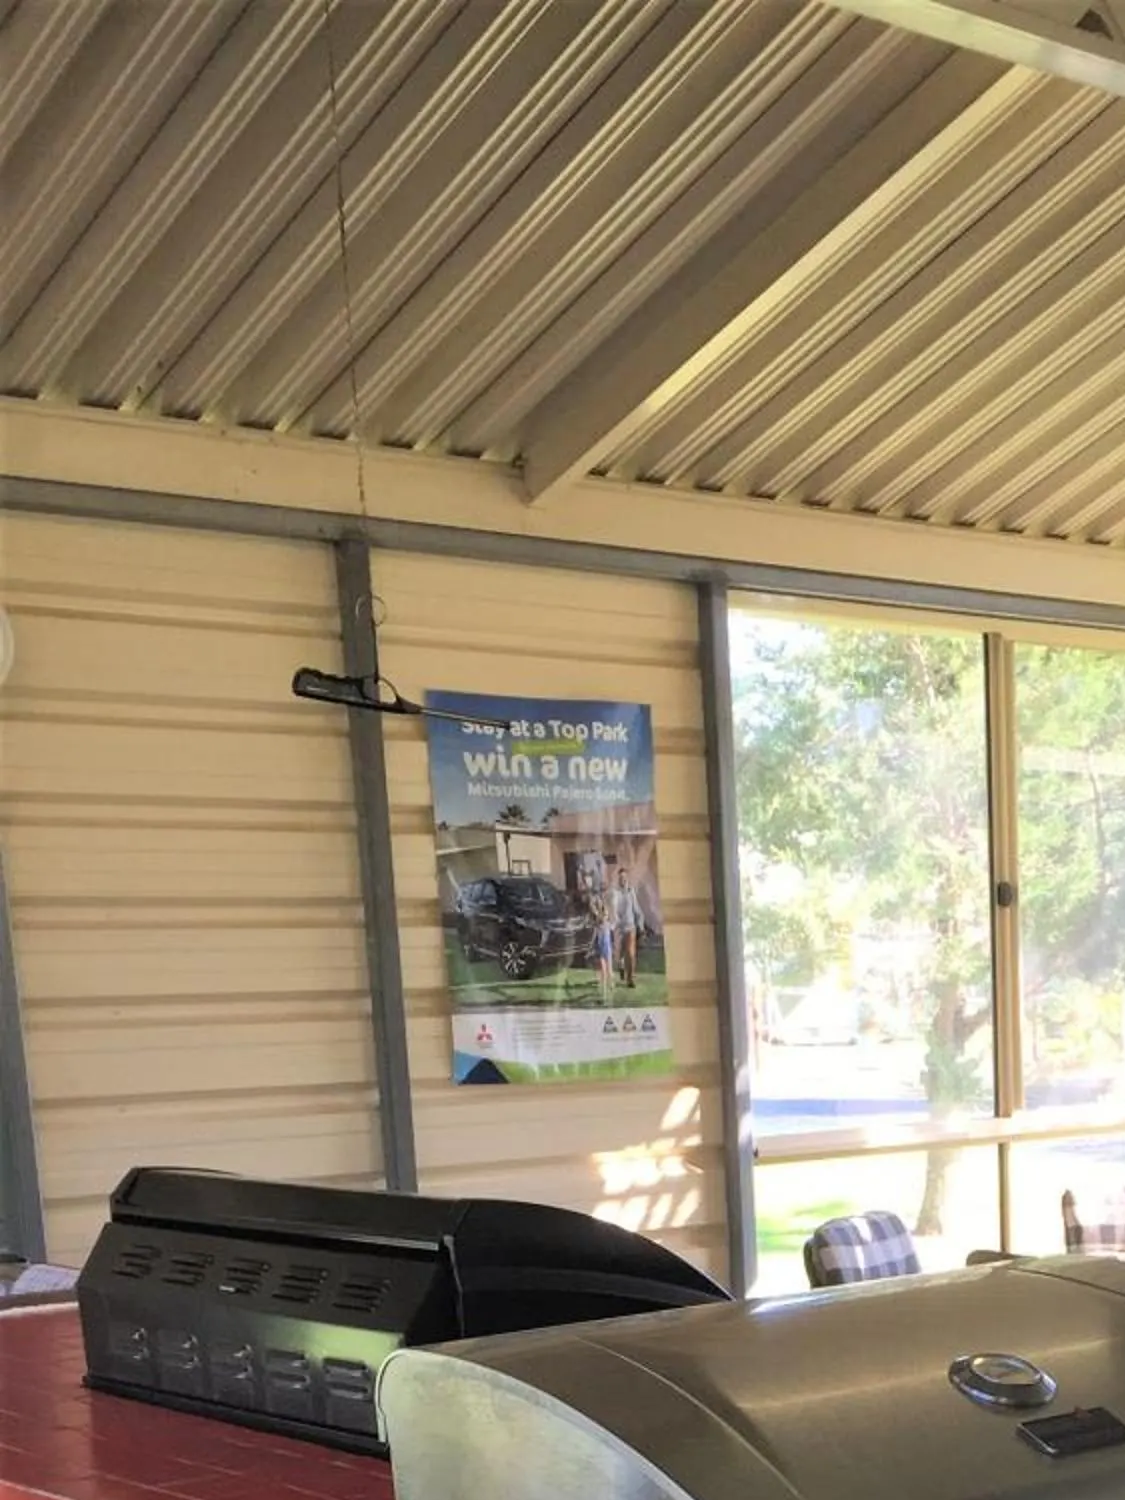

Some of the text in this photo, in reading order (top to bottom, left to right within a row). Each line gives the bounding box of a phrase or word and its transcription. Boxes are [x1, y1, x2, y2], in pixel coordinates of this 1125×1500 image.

[461, 719, 629, 745] Stay at a Top Park
[463, 744, 629, 782] win a new
[467, 781, 550, 798] Mitsubishi
